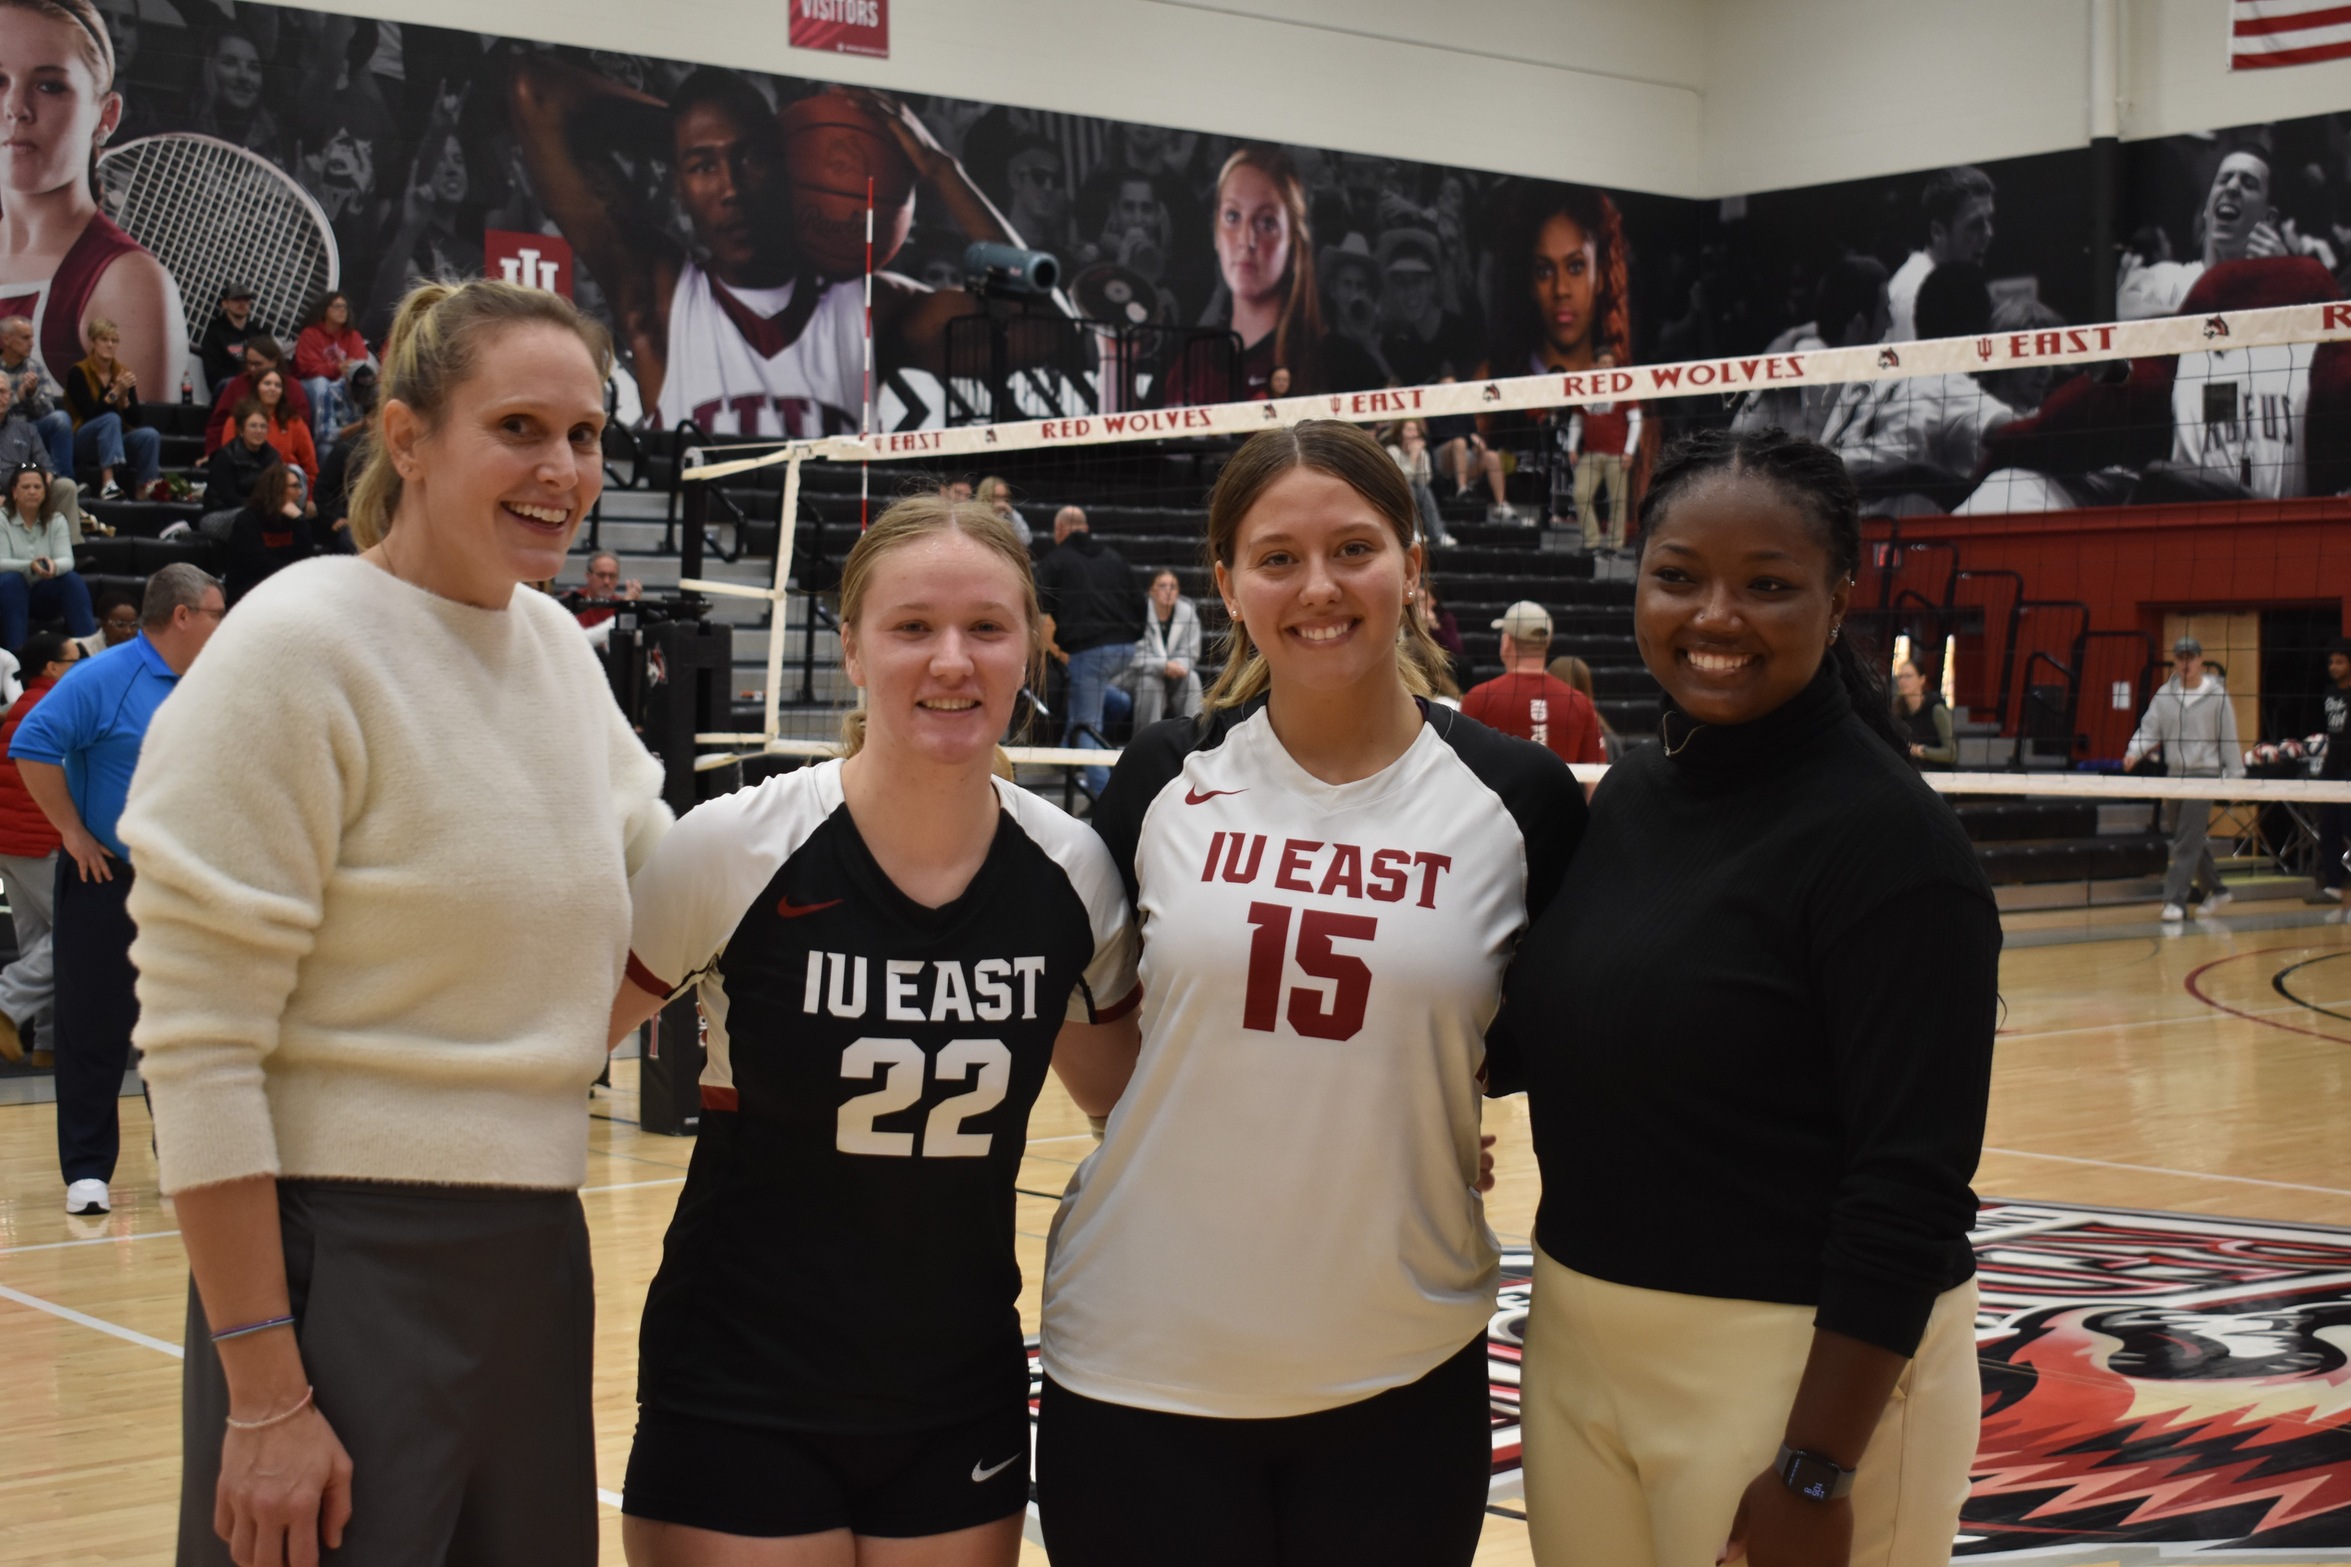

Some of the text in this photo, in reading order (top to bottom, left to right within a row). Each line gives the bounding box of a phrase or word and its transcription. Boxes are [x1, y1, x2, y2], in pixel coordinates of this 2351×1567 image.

[801, 0, 879, 28] VISITORS
[2009, 326, 2118, 359] EAST
[1563, 355, 1805, 397] RED WOLVES
[1352, 388, 1425, 414] EAST
[890, 431, 945, 453] EAST
[1041, 408, 1213, 439] RED WOLVES
[1200, 831, 1453, 910] IU EAST
[802, 949, 1046, 1022] IU EAST
[1242, 900, 1379, 1042] 15
[835, 1036, 1013, 1158] 22
